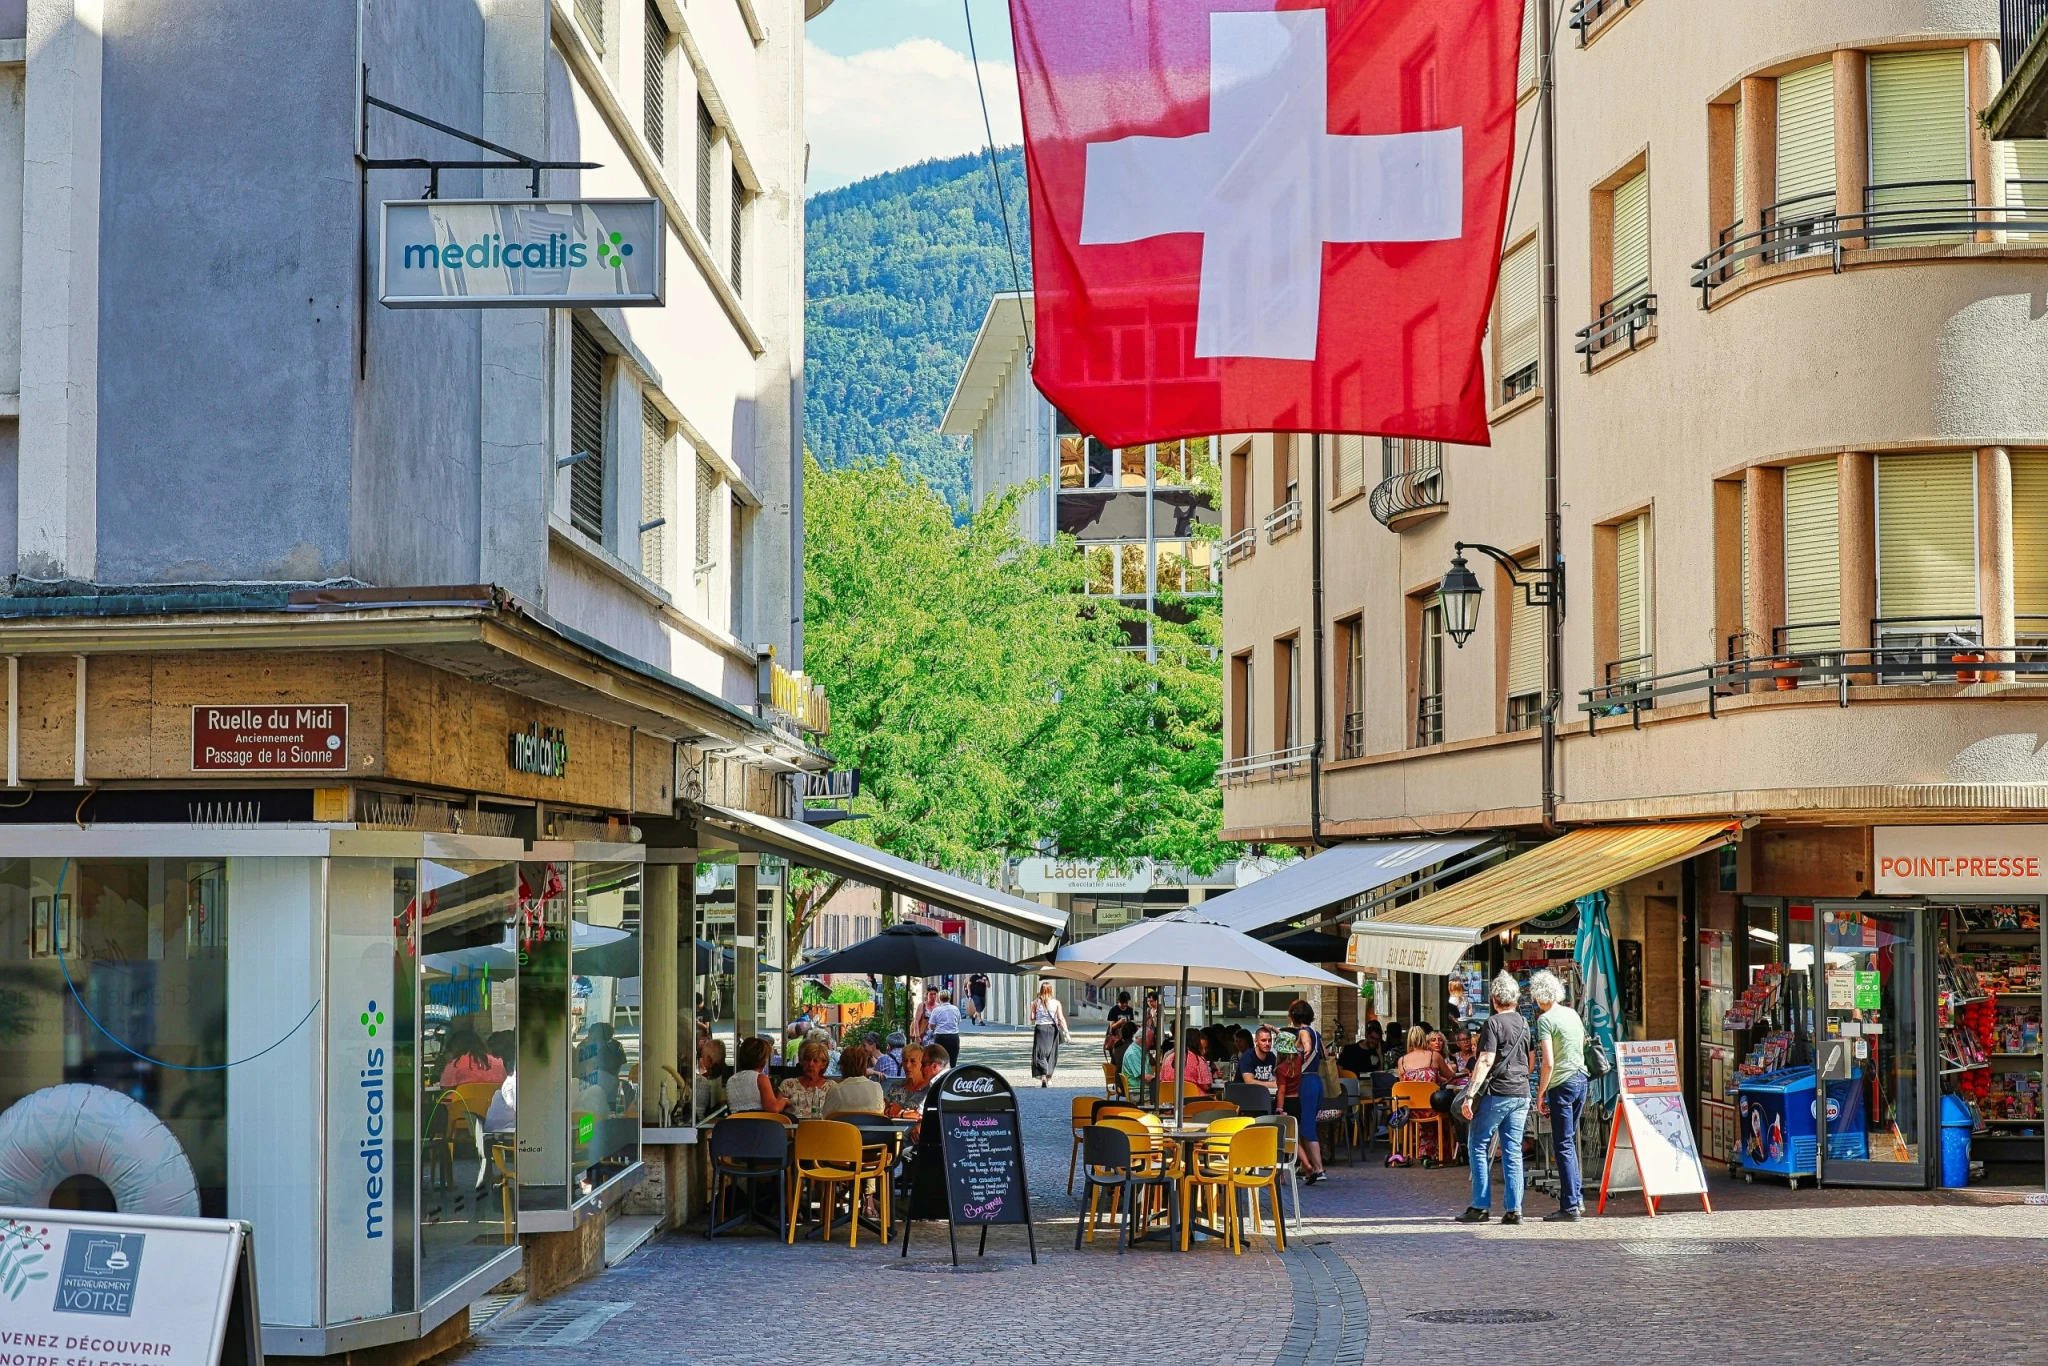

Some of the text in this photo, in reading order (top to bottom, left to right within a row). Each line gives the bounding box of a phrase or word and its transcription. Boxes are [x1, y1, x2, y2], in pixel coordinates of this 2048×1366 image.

[404, 233, 587, 269] medicalis
[208, 709, 332, 730] Ruelle du Midi
[235, 733, 304, 743] Anciennement
[206, 746, 332, 766] Passage de la Sionne
[1881, 857, 2040, 878] POINT-PRESSE
[1637, 1045, 1661, 1053] GAGNER
[958, 1116, 971, 1127] Nos
[360, 1047, 384, 1239] medicalis
[963, 1203, 984, 1219] Bon
[1, 1331, 172, 1356] VENEZ DÉCOUVRIR
[0, 1353, 59, 1366] NOTRE
